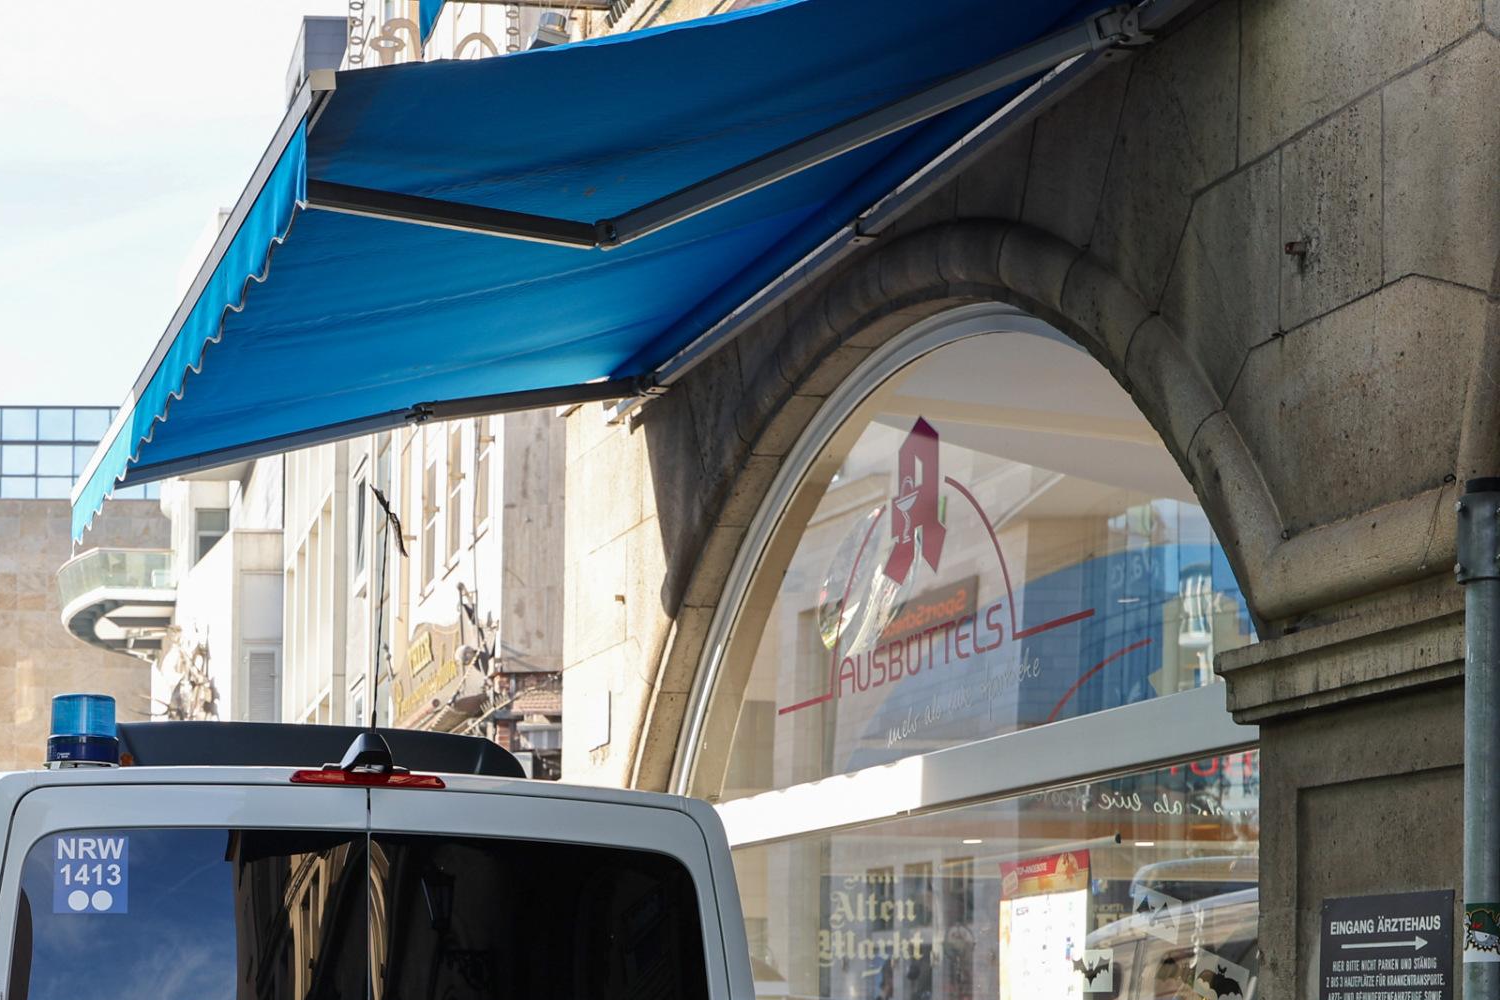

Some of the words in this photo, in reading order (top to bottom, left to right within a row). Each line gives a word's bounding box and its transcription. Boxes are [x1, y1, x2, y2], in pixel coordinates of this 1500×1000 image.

[838, 603, 1002, 698] AUSBÜTTELS
[57, 838, 125, 859] NRW
[60, 863, 122, 886] 1413
[829, 891, 917, 929] Alten
[1330, 919, 1375, 935] EINGANG
[1377, 915, 1441, 933] ÄRZTEHAUS
[1332, 960, 1344, 972] HIER
[1346, 959, 1360, 971] BITTE
[1361, 959, 1376, 970] NICHT
[1378, 958, 1399, 970] PARKEN
[1401, 958, 1412, 969] UND
[1414, 956, 1437, 969] STÄNDIG
[1331, 976, 1339, 987] BIS
[1376, 973, 1386, 987] FÜR
